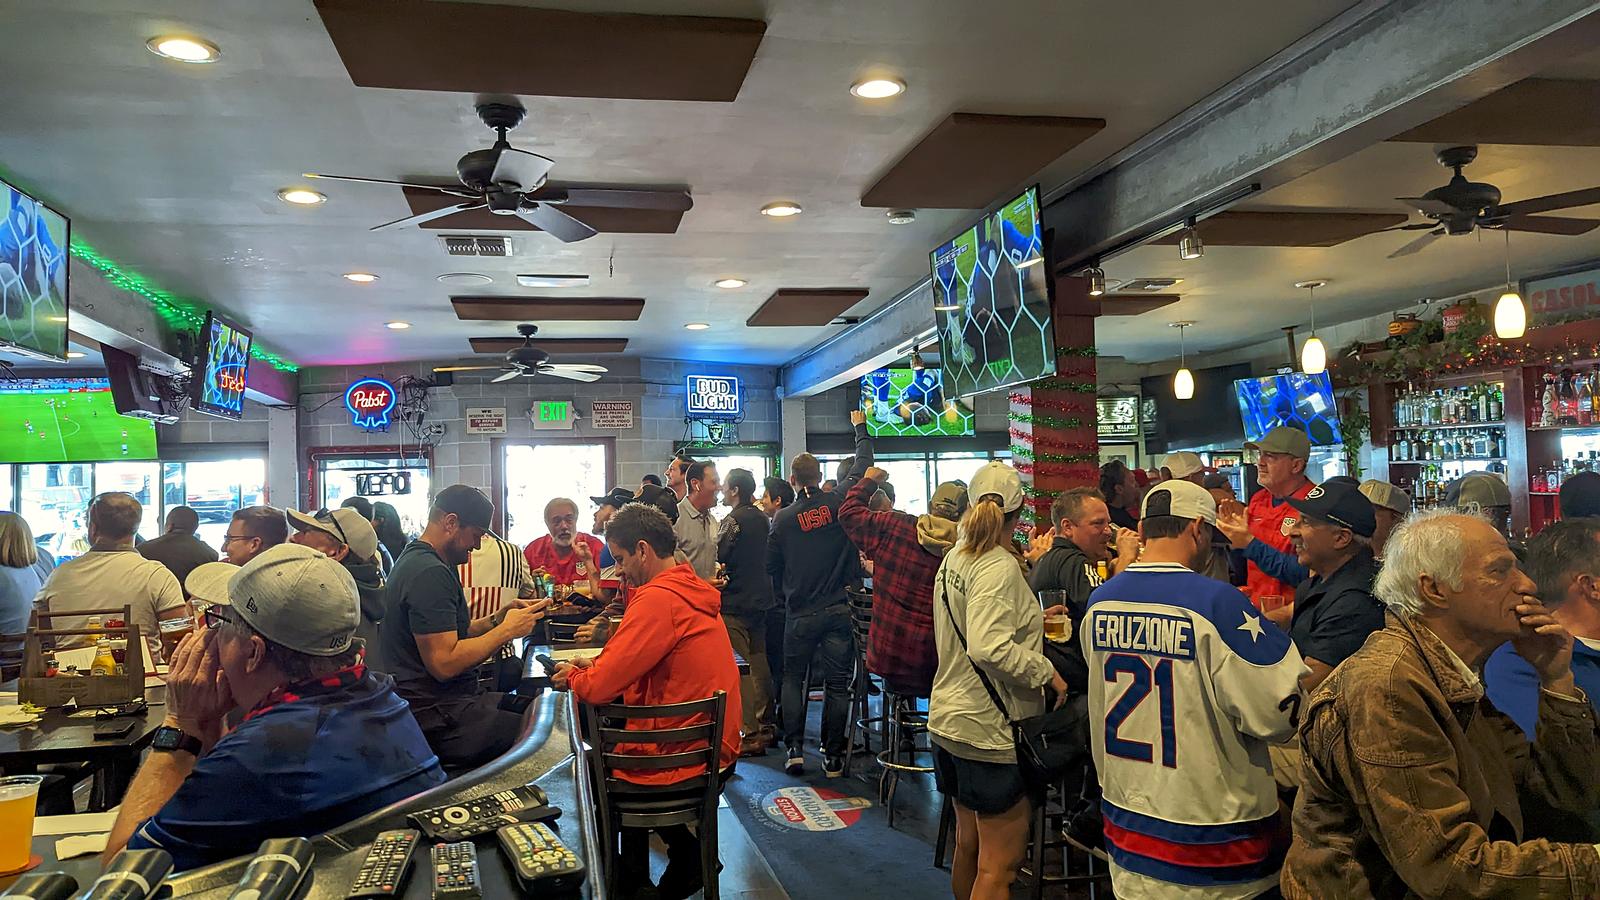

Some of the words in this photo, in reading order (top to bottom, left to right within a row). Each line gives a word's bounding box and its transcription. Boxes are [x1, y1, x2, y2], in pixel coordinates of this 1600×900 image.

[697, 378, 730, 394] BUD
[353, 390, 388, 408] Pabst
[691, 393, 736, 410] LIGHT
[540, 402, 568, 422] EXIT
[797, 505, 832, 531] USA
[1095, 614, 1192, 656] ERUZIONE
[1104, 653, 1177, 769] 21
[776, 798, 802, 821] STATION
[791, 788, 835, 828] STANDARD
